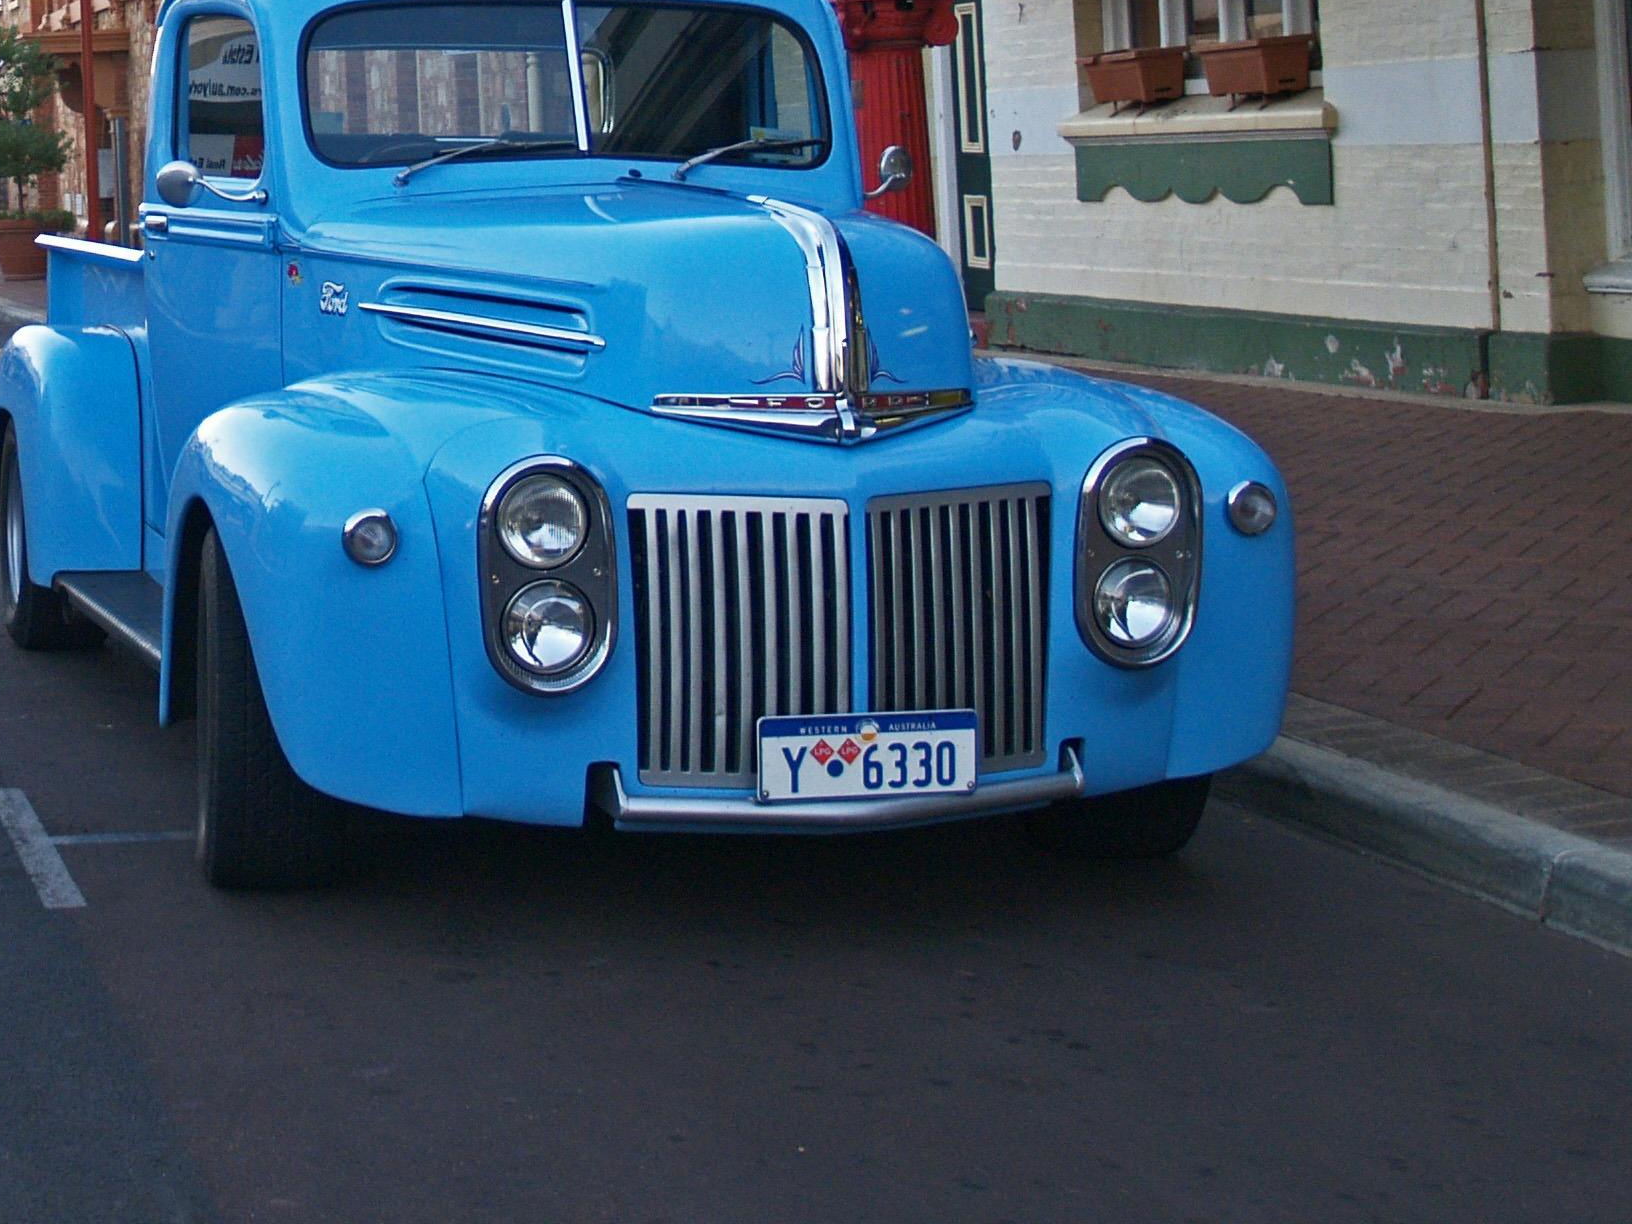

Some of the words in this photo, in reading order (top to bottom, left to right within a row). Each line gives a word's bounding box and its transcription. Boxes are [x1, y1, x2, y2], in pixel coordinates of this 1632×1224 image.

[319, 281, 349, 316] Ford
[799, 725, 848, 736] WESTERN
[888, 721, 937, 733] AUSTRALIA
[814, 747, 832, 756] LPG
[841, 746, 858, 755] LPG
[781, 746, 808, 794] Y
[862, 740, 957, 790] 6330
